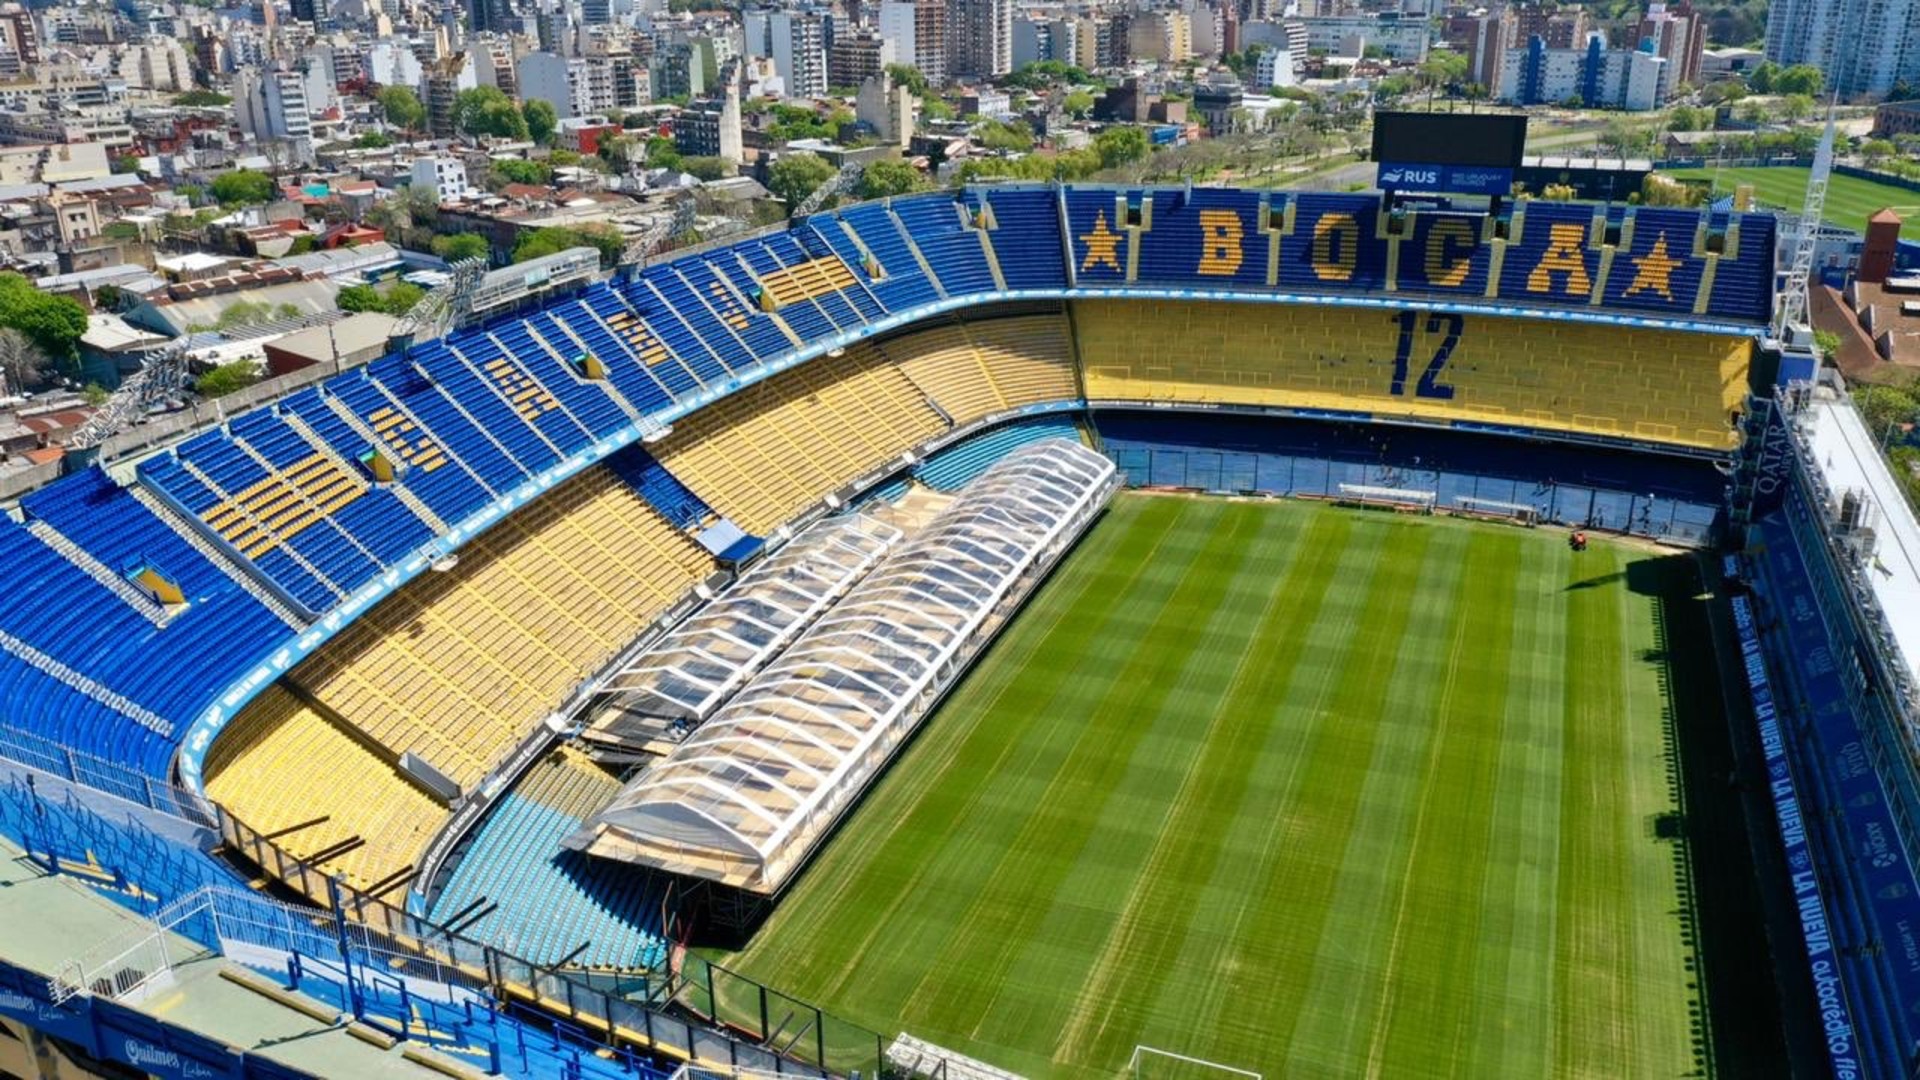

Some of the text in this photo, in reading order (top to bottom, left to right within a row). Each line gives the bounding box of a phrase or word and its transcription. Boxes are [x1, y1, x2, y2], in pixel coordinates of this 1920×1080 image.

[1404, 170, 1437, 184] RUS
[1197, 208, 1591, 296] BOCA
[1389, 310, 1463, 400] 12
[1758, 424, 1787, 494] QATAR
[1741, 639, 1767, 688] LA NUEVA
[1756, 701, 1784, 760] LA NUEVA
[1772, 777, 1805, 848] LA NUEVA
[1792, 870, 1816, 895] LA
[1797, 894, 1831, 956] NUEVA
[1811, 960, 1852, 1055] autocrédito
[125, 1039, 180, 1069] Quilmes
